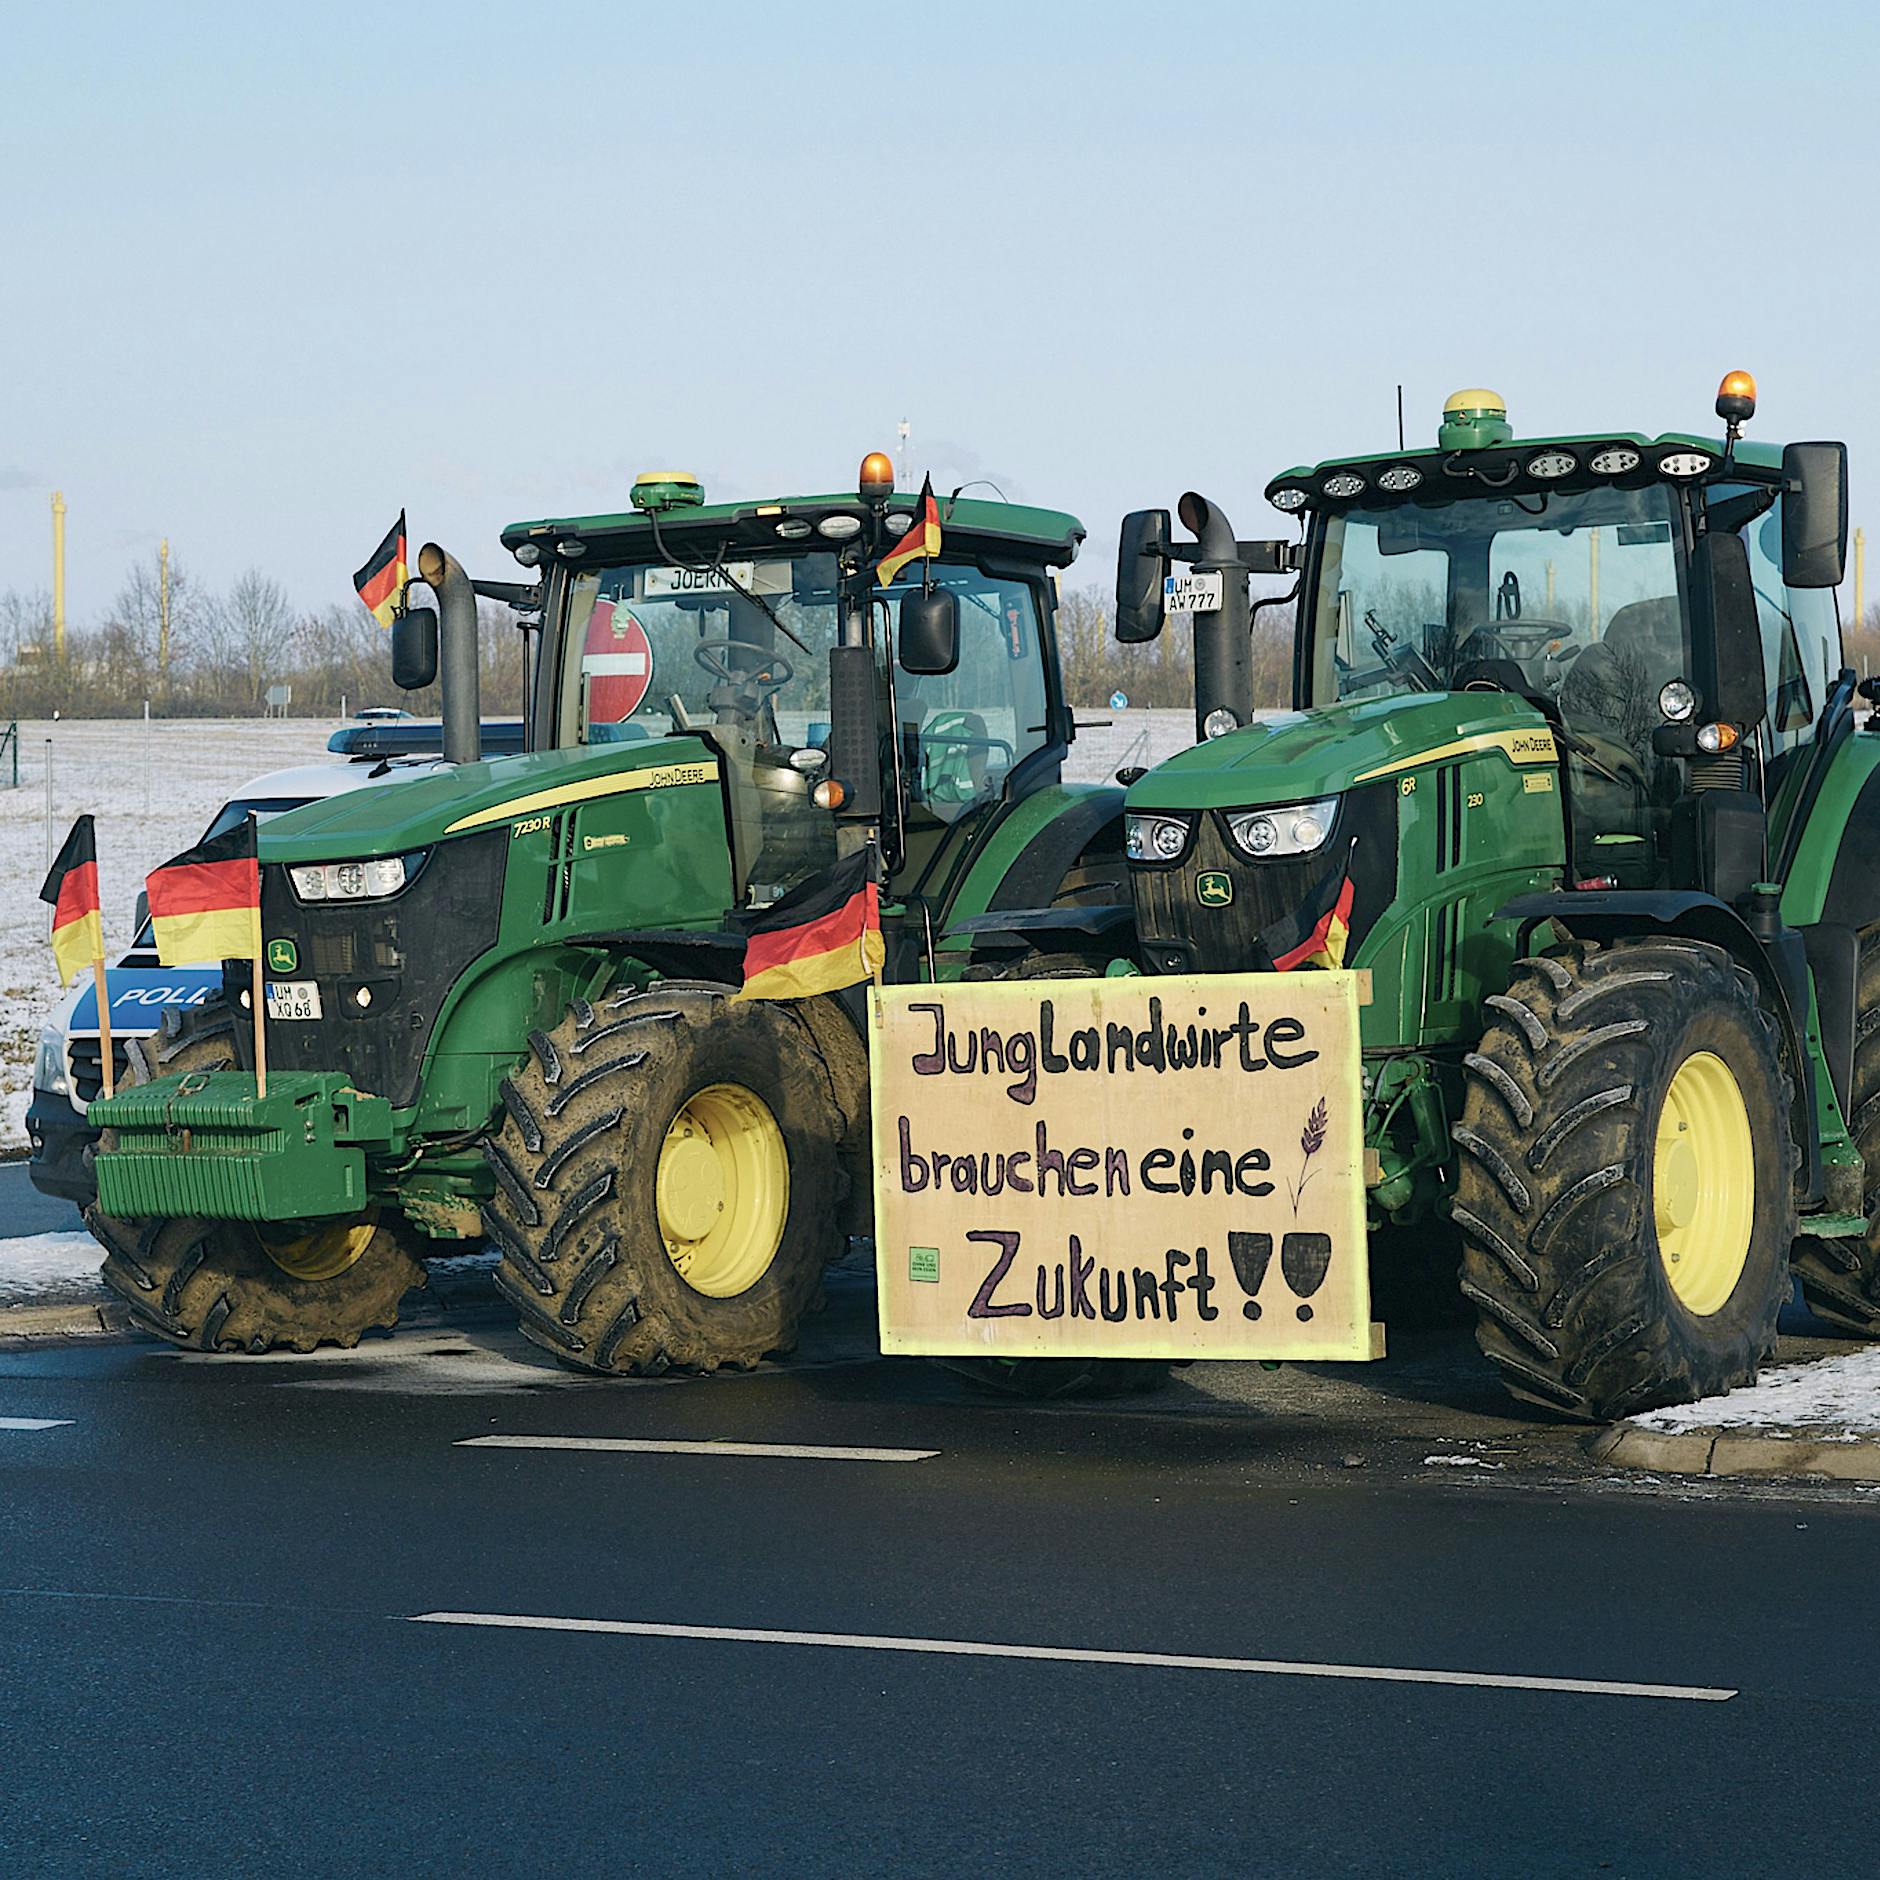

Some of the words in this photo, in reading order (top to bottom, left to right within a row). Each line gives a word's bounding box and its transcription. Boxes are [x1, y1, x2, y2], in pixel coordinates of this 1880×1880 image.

[1175, 578, 1192, 593] UM
[1169, 595, 1185, 610] AW
[1188, 593, 1215, 609] 777
[1512, 738, 1530, 752] JOHN
[1530, 737, 1552, 752] DEERE
[649, 770, 674, 786] JOHN
[674, 768, 704, 782] DEERE
[1401, 776, 1416, 795] 6R
[1467, 793, 1484, 808] 230
[112, 987, 208, 1008] POLI
[275, 985, 292, 1000] UM
[899, 1116, 1130, 1197] brauchen
[1140, 1128, 1275, 1197] eine
[966, 1230, 1332, 1322] Zukunft!!
